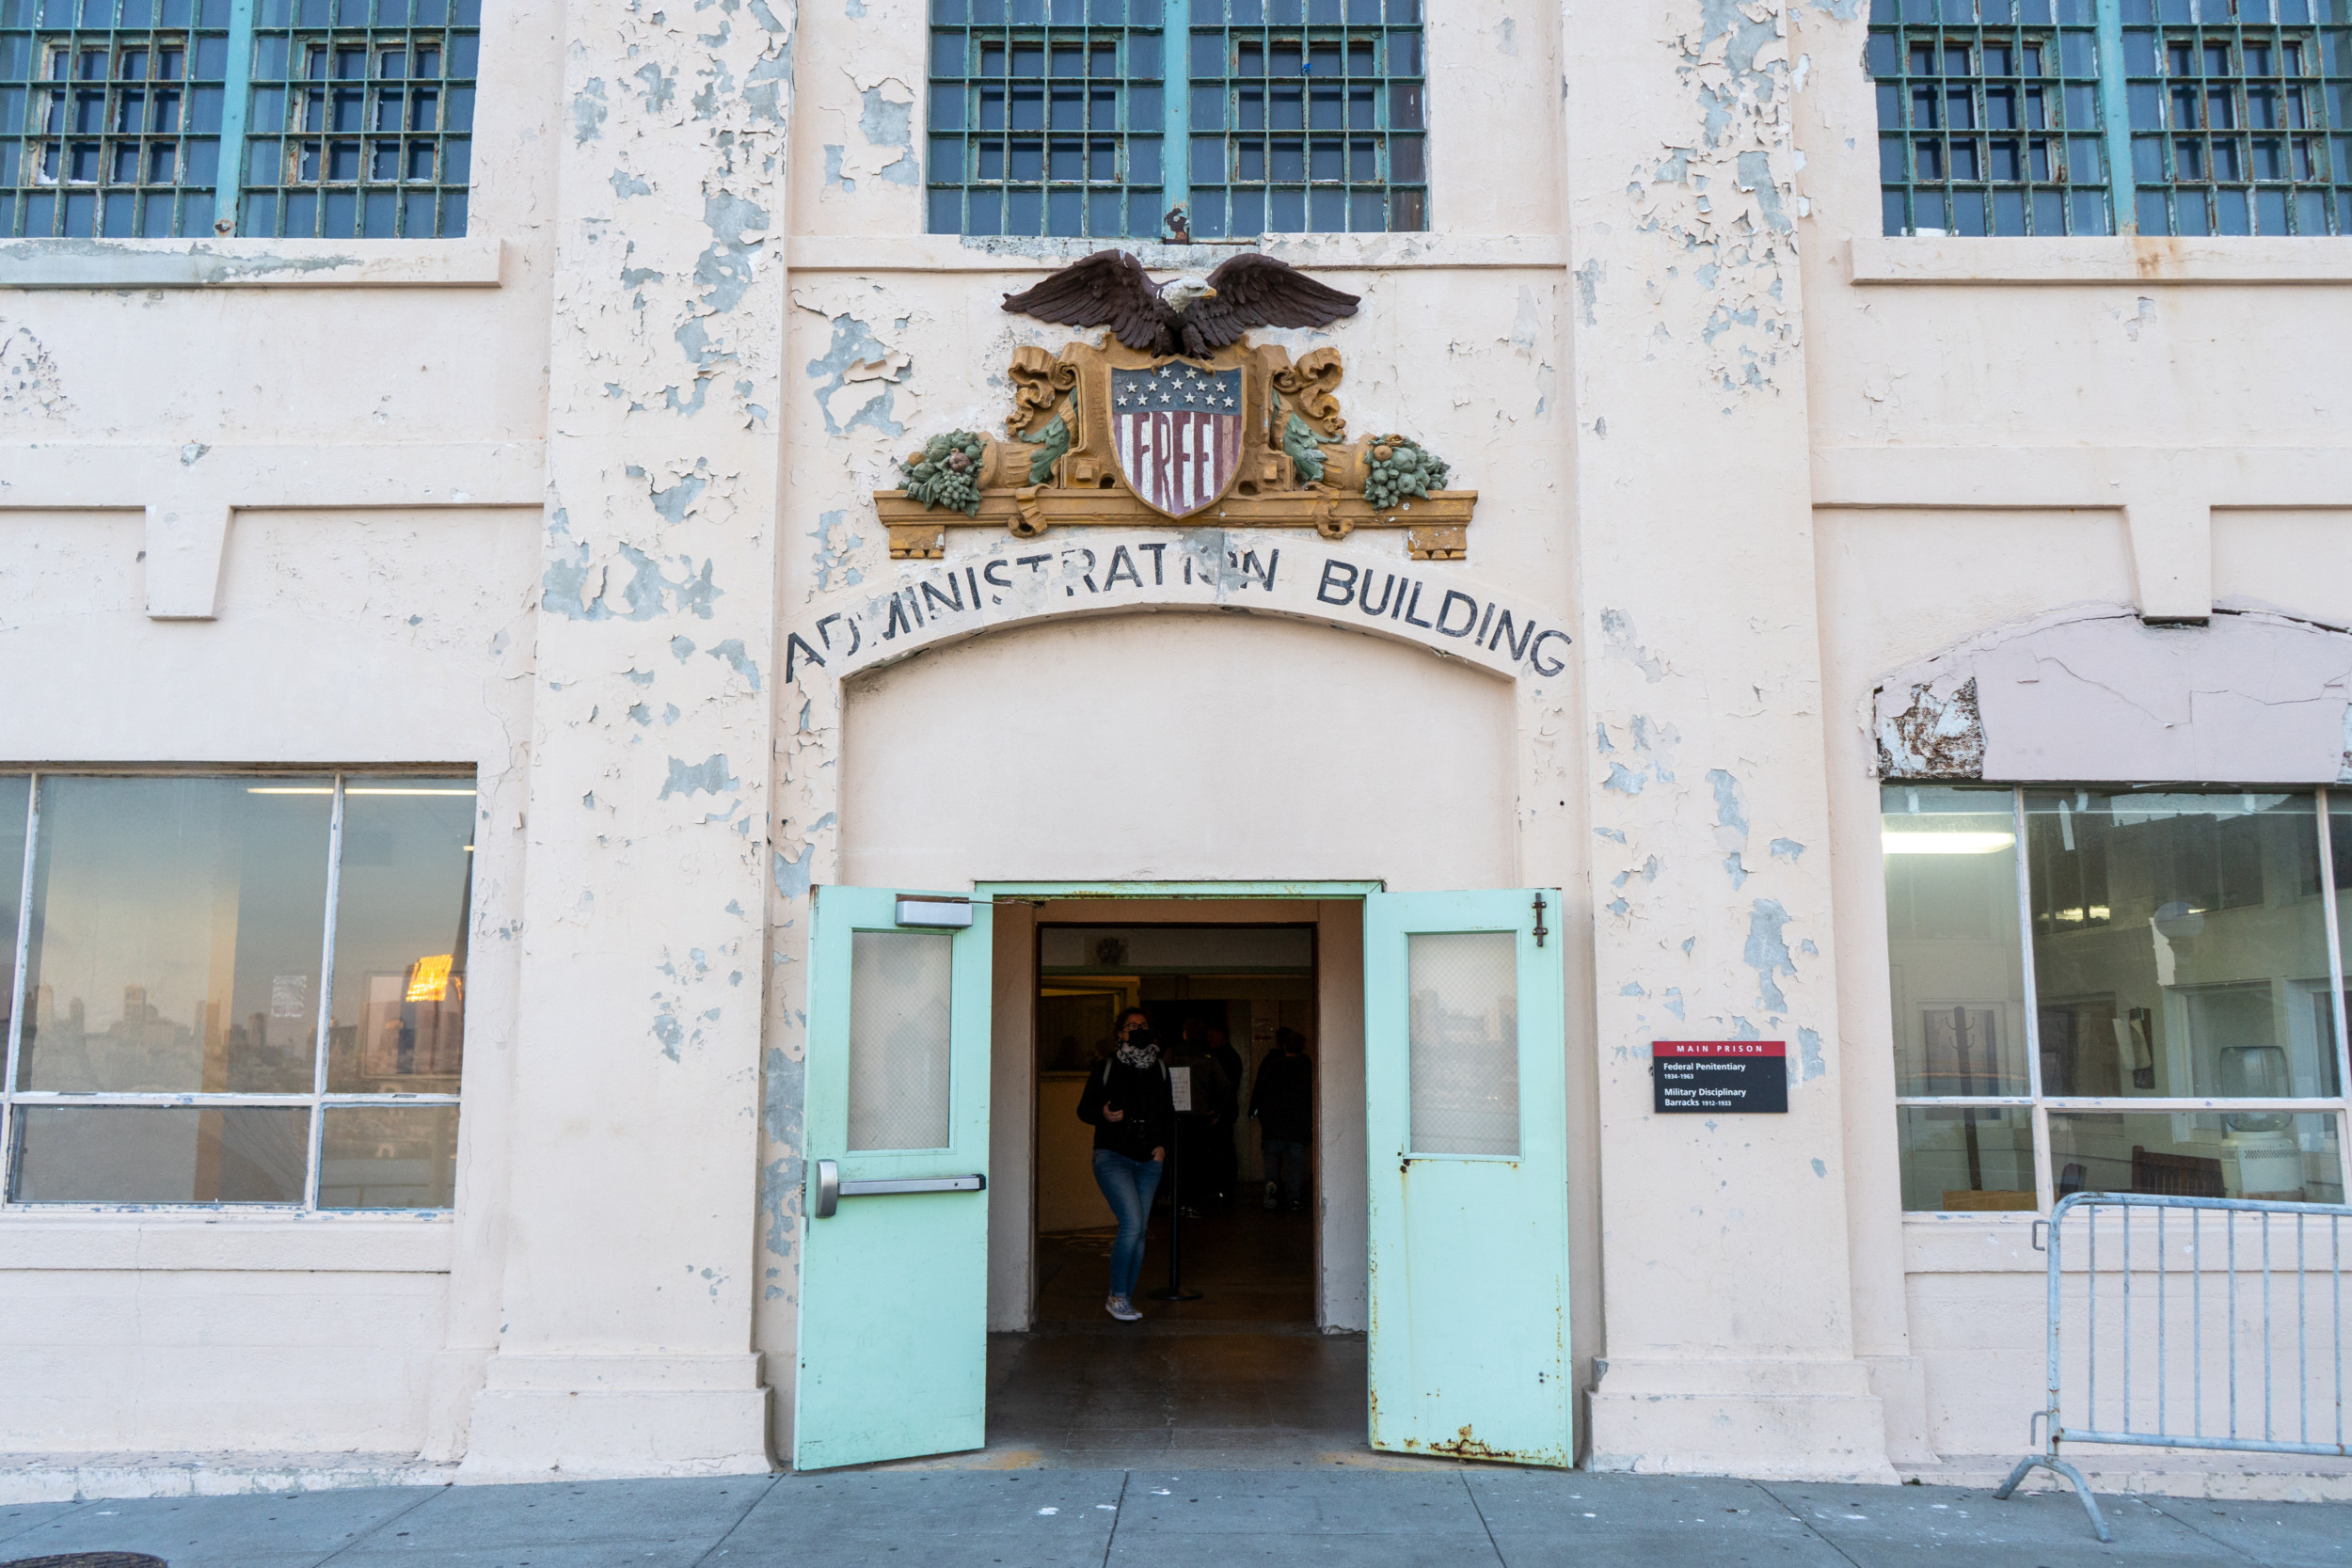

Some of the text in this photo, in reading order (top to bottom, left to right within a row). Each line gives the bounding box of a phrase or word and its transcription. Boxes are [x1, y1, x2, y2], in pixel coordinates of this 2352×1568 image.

[1133, 412, 1212, 515] FREE
[1316, 558, 1572, 678] BUILDING
[1664, 1088, 1746, 1098] Military Disciplinary
[1695, 1063, 1746, 1071] Penitentiary
